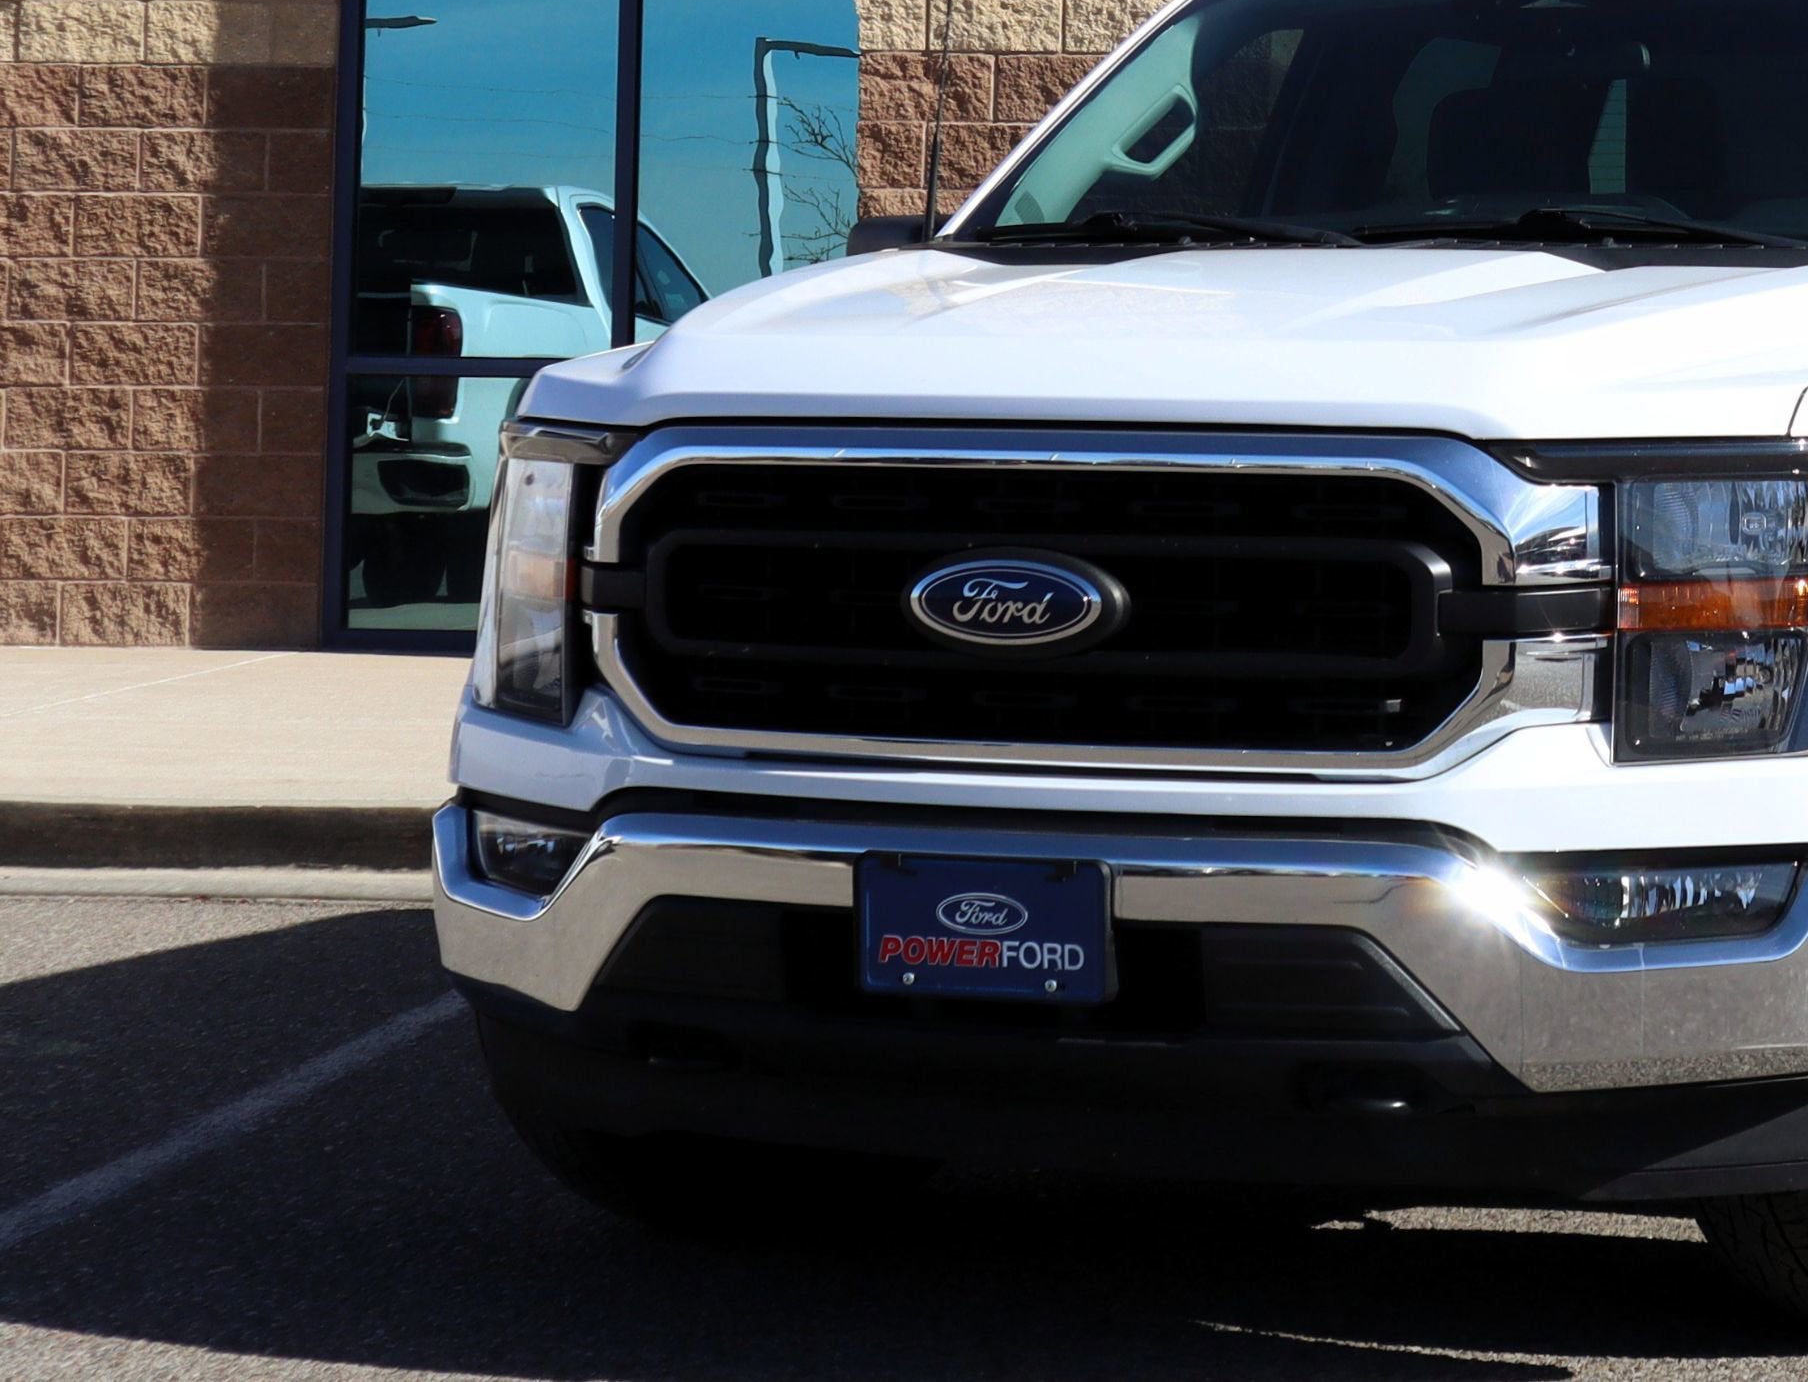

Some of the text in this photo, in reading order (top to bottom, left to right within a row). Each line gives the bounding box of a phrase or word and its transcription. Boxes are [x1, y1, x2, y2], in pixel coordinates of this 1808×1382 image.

[952, 577, 1055, 625] Ford
[954, 899, 1009, 926] Ford
[877, 934, 1085, 971] POWERFORD
